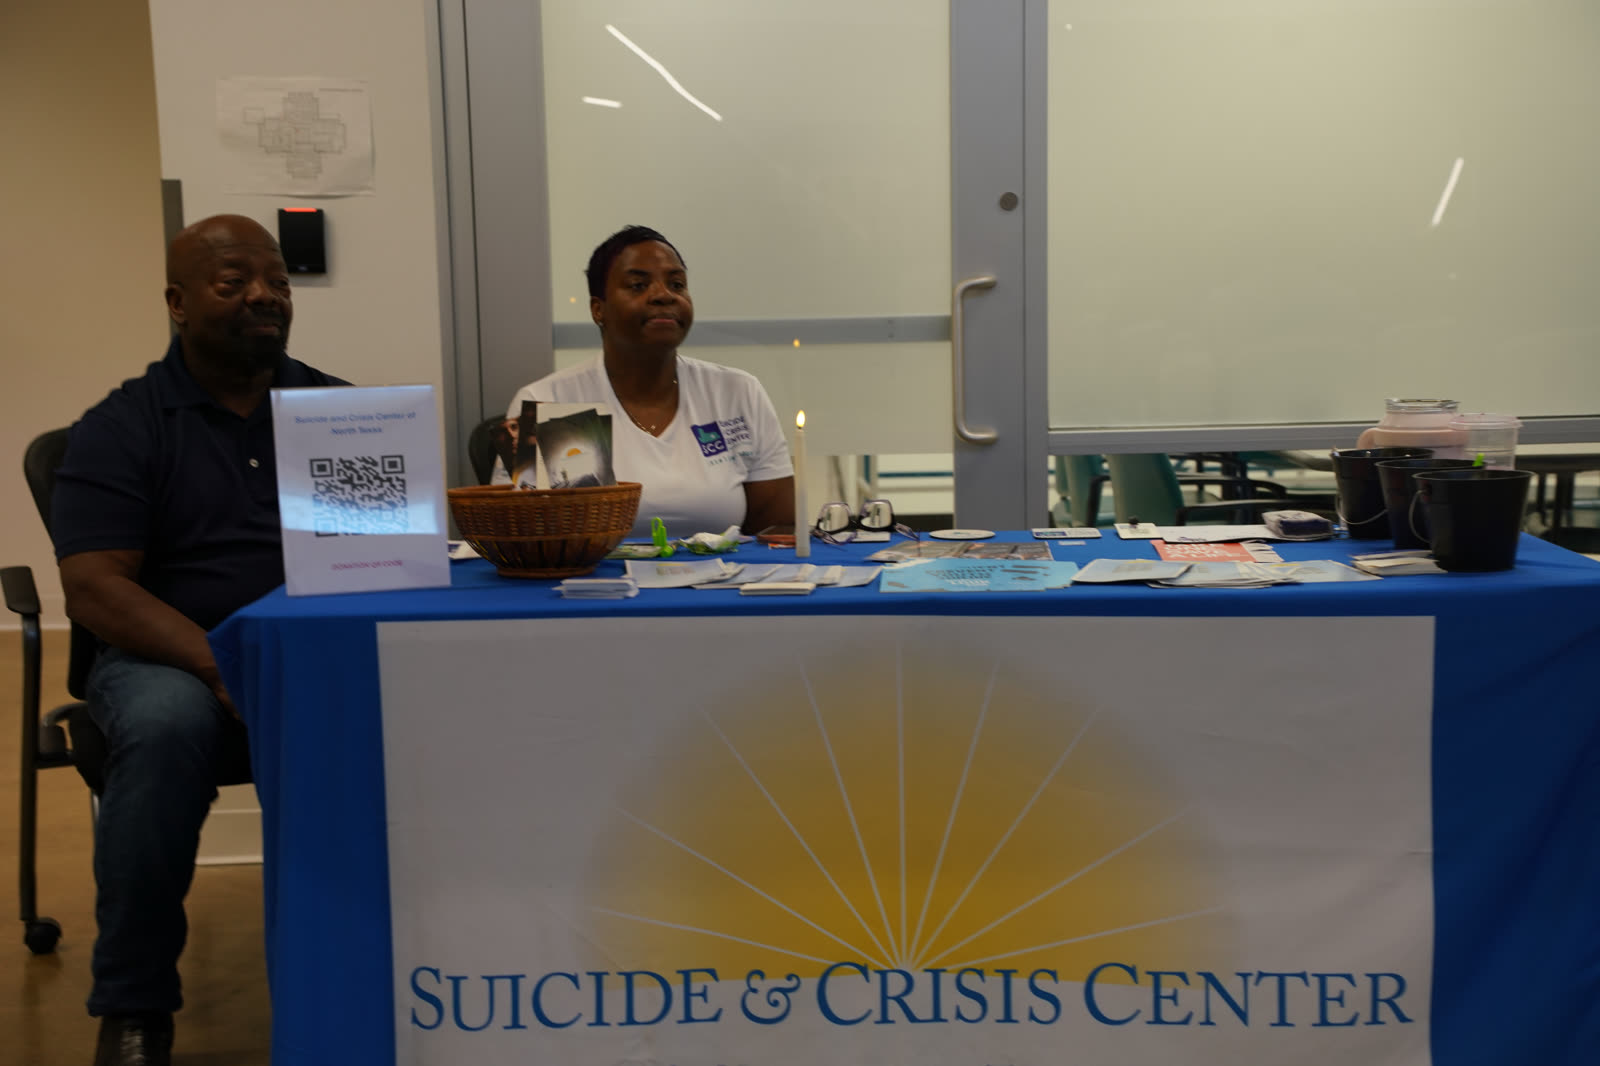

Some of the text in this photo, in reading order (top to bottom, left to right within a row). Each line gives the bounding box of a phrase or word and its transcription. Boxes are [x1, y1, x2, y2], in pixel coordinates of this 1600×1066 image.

[411, 963, 1413, 1030] SUICIDE & CRISIS CENTER
